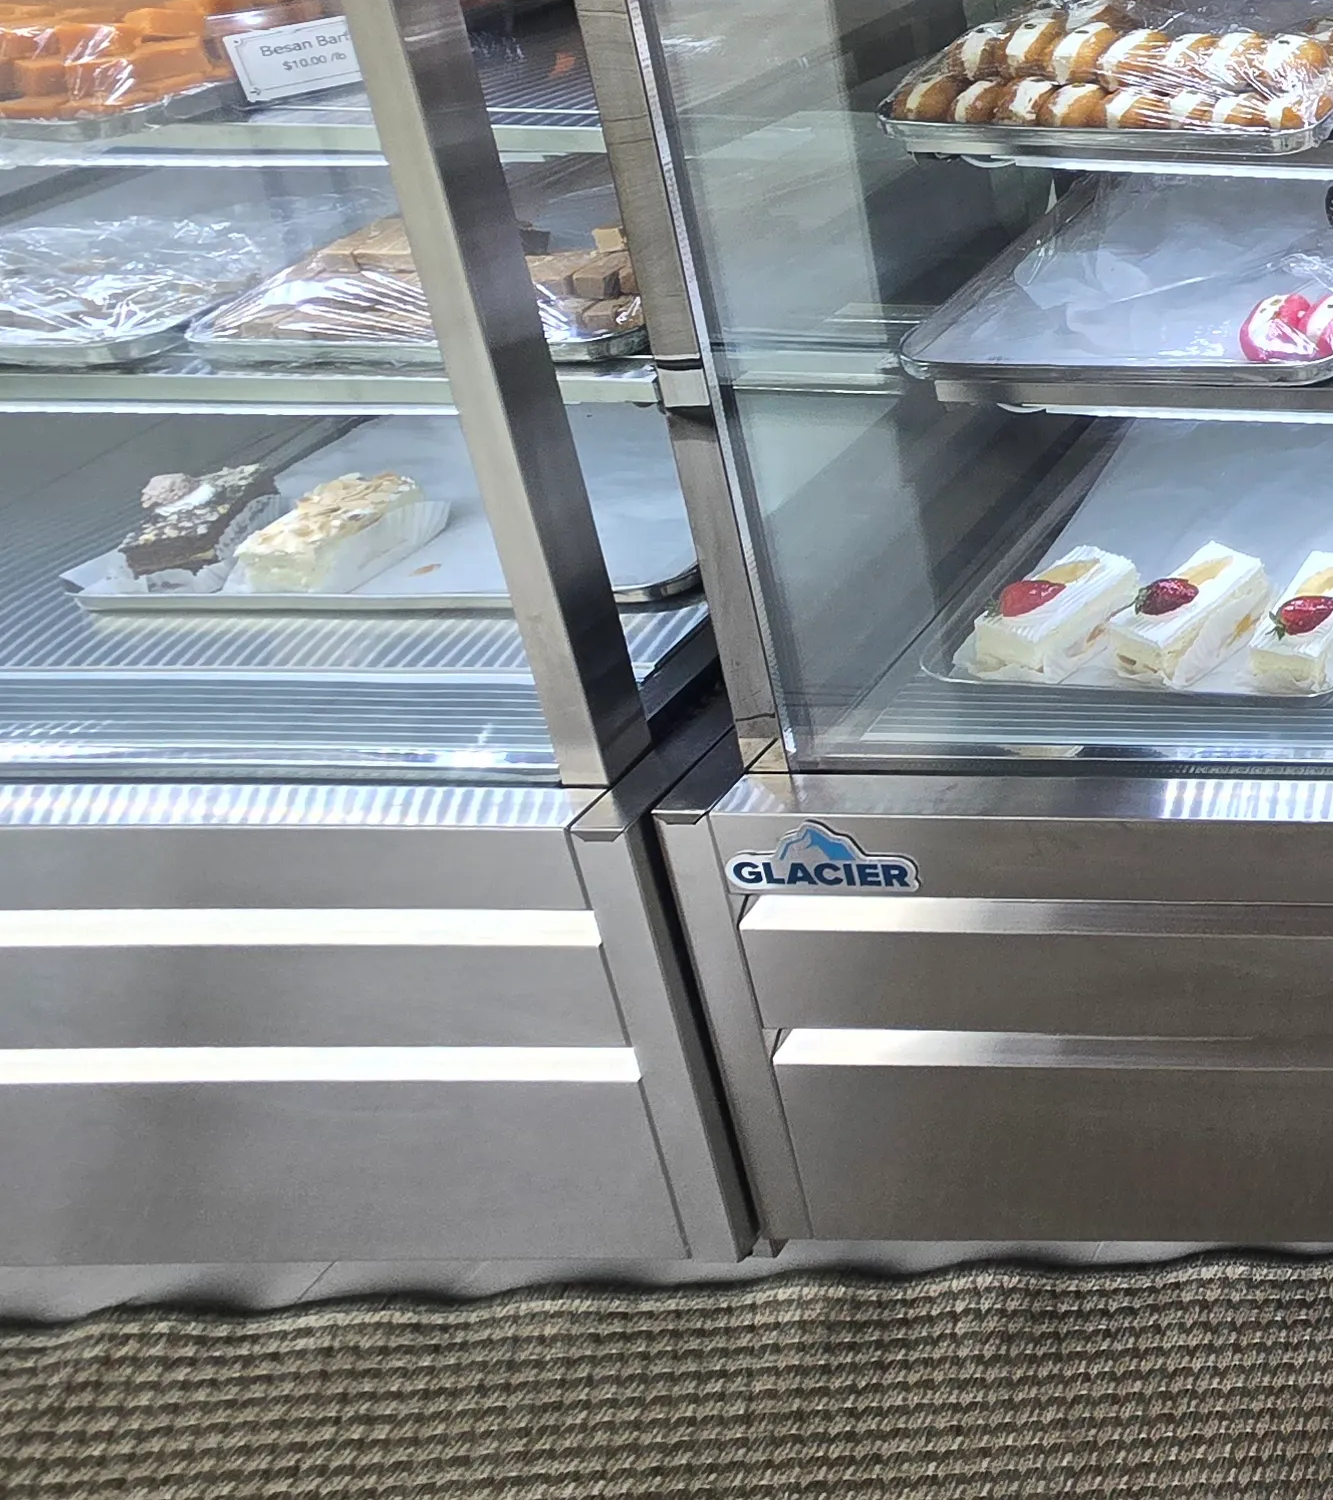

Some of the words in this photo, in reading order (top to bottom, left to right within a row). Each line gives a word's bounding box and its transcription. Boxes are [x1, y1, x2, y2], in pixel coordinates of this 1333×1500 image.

[259, 40, 313, 57] Besan
[282, 55, 328, 71] $10.00
[330, 51, 347, 62] /lb
[732, 861, 911, 888] GLACIER
